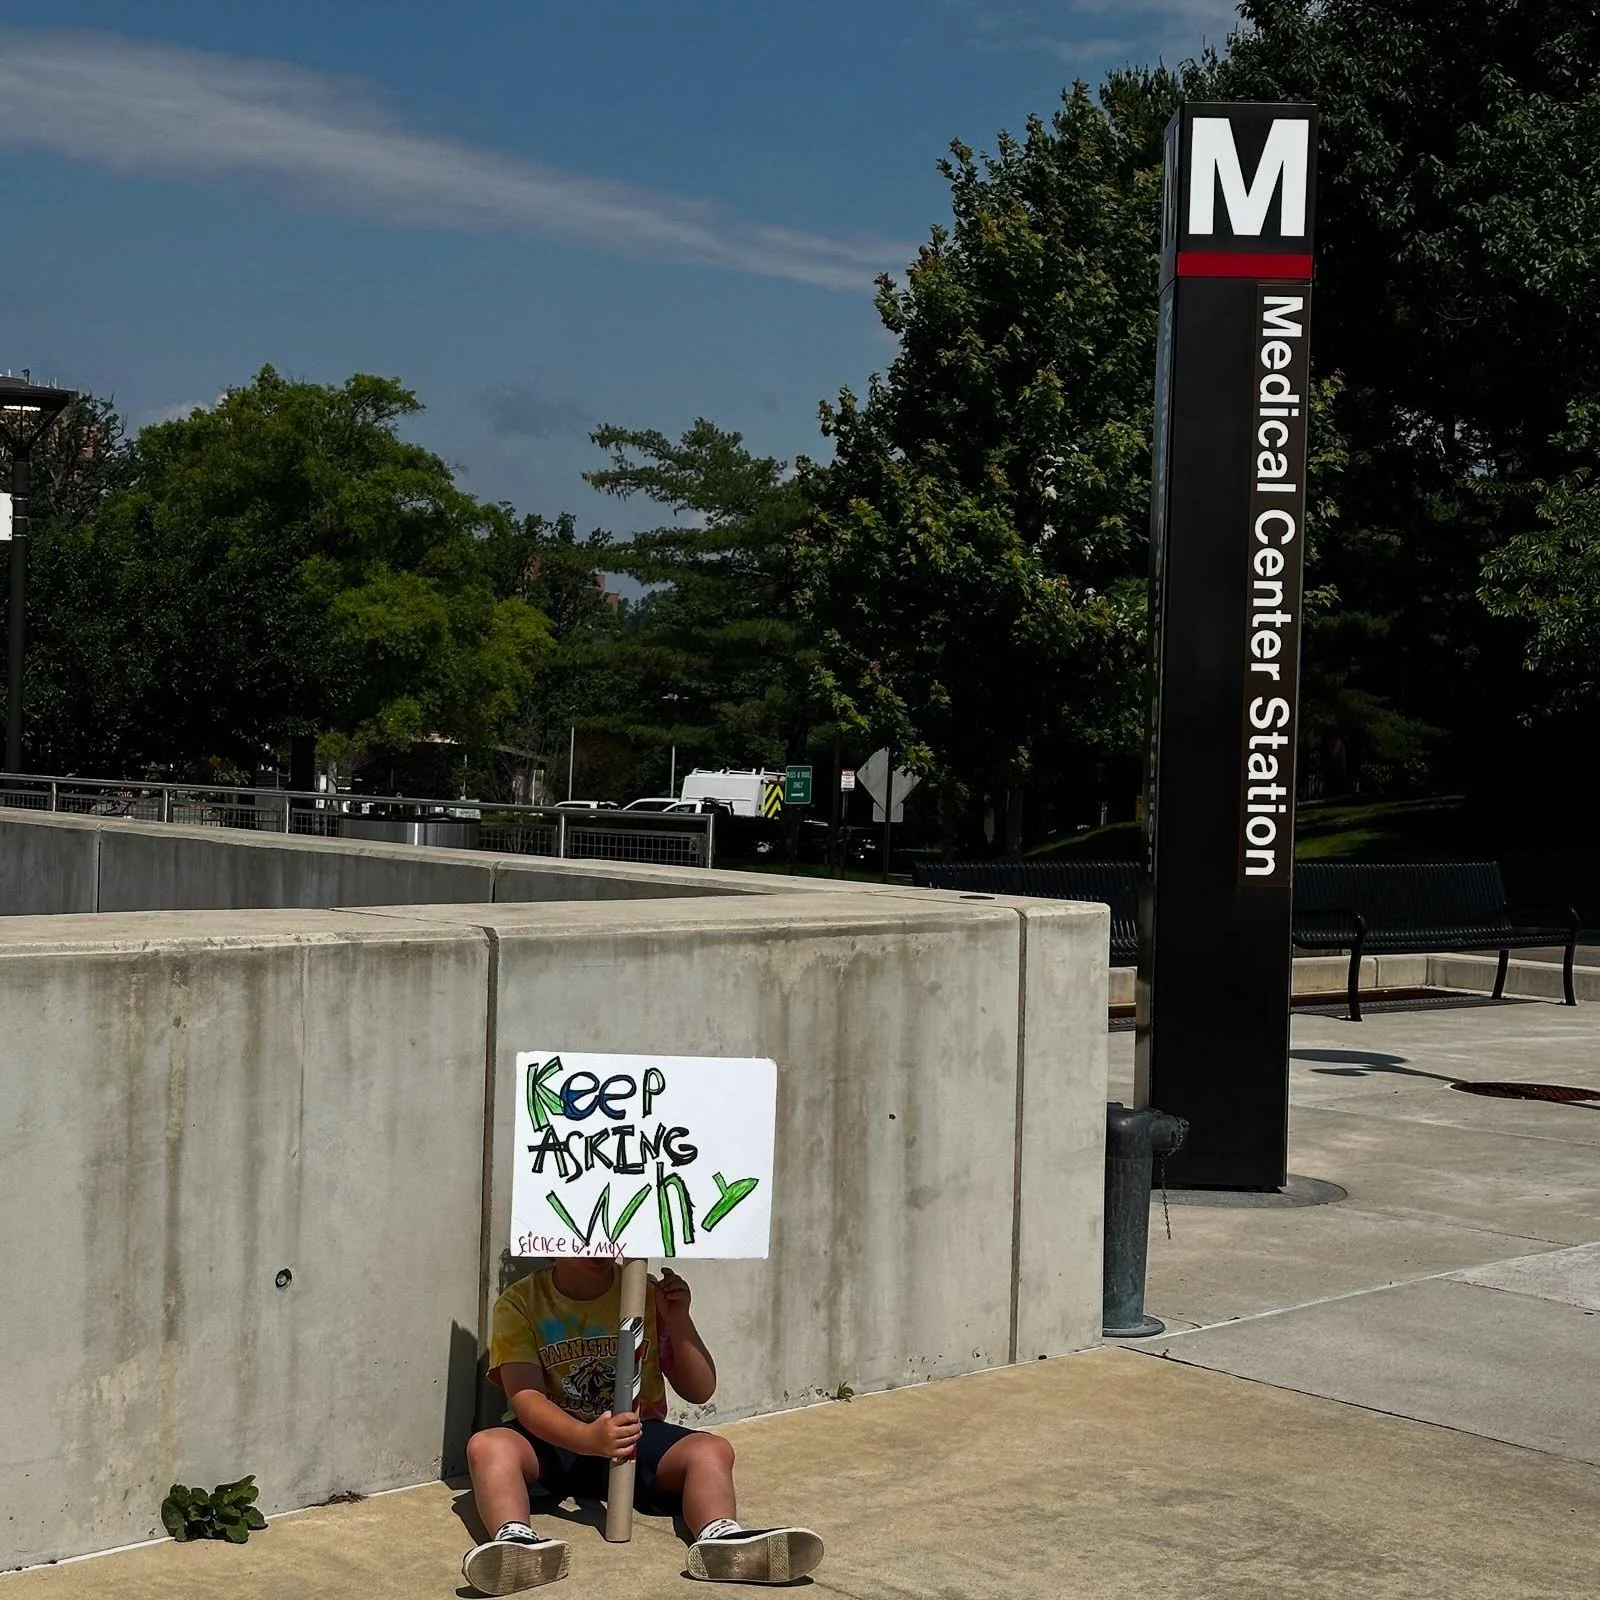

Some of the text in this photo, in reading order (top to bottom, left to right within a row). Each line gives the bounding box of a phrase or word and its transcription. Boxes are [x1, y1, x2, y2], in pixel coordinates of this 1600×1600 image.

[1188, 117, 1309, 237] M
[1147, 298, 1173, 872] Medical Center Station
[1244, 296, 1304, 876] Medical Center Station
[527, 1122, 698, 1183] ASKING
